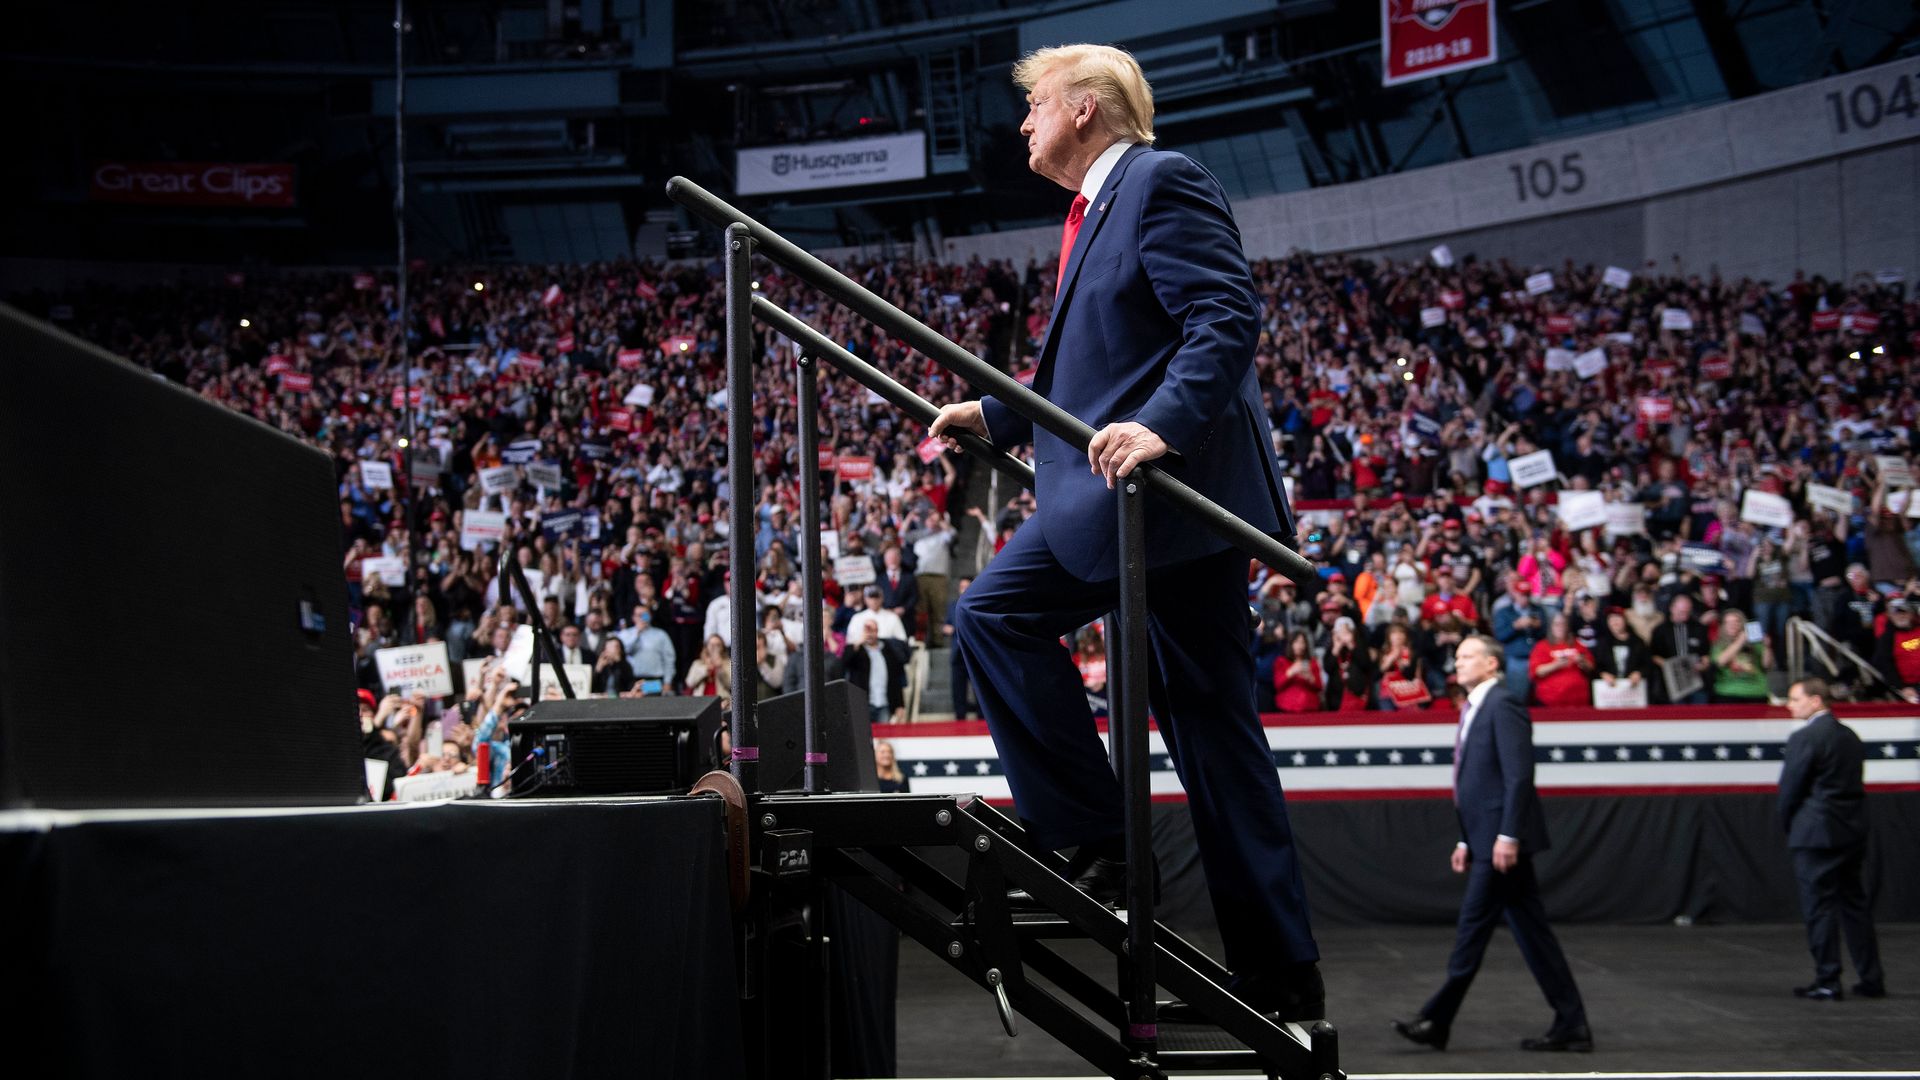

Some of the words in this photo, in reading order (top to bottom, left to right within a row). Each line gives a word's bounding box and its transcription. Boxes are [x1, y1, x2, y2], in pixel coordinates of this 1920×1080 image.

[793, 149, 888, 171] Husqvarna
[95, 163, 196, 193] Great
[201, 166, 283, 201] Clips
[1508, 151, 1586, 202] 105
[386, 664, 444, 680] AMERICA
